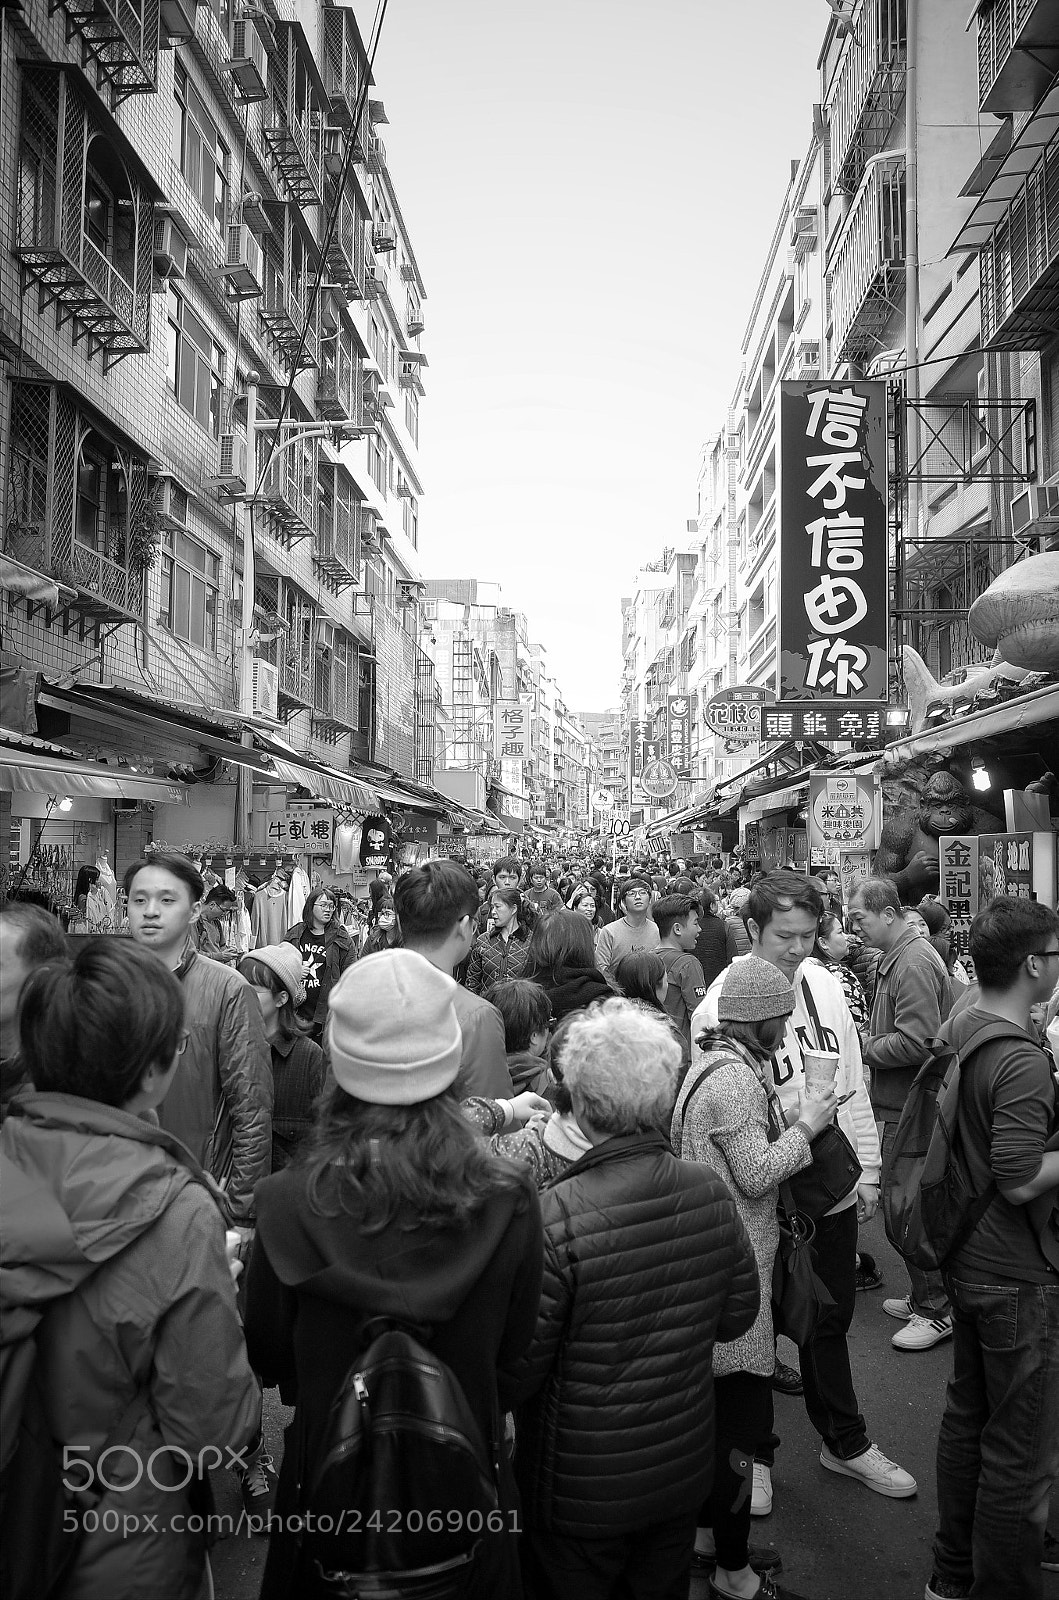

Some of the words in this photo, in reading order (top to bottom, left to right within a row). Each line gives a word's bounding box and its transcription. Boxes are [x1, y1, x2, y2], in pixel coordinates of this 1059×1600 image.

[803, 387, 868, 695] 信不信由你
[501, 709, 524, 757] 格子趣
[670, 718, 683, 769] 高登皮件
[268, 820, 329, 841] 牛軋糖
[606, 819, 631, 836] 100
[822, 820, 863, 829] 趣味樂園
[300, 979, 321, 989] TAR
